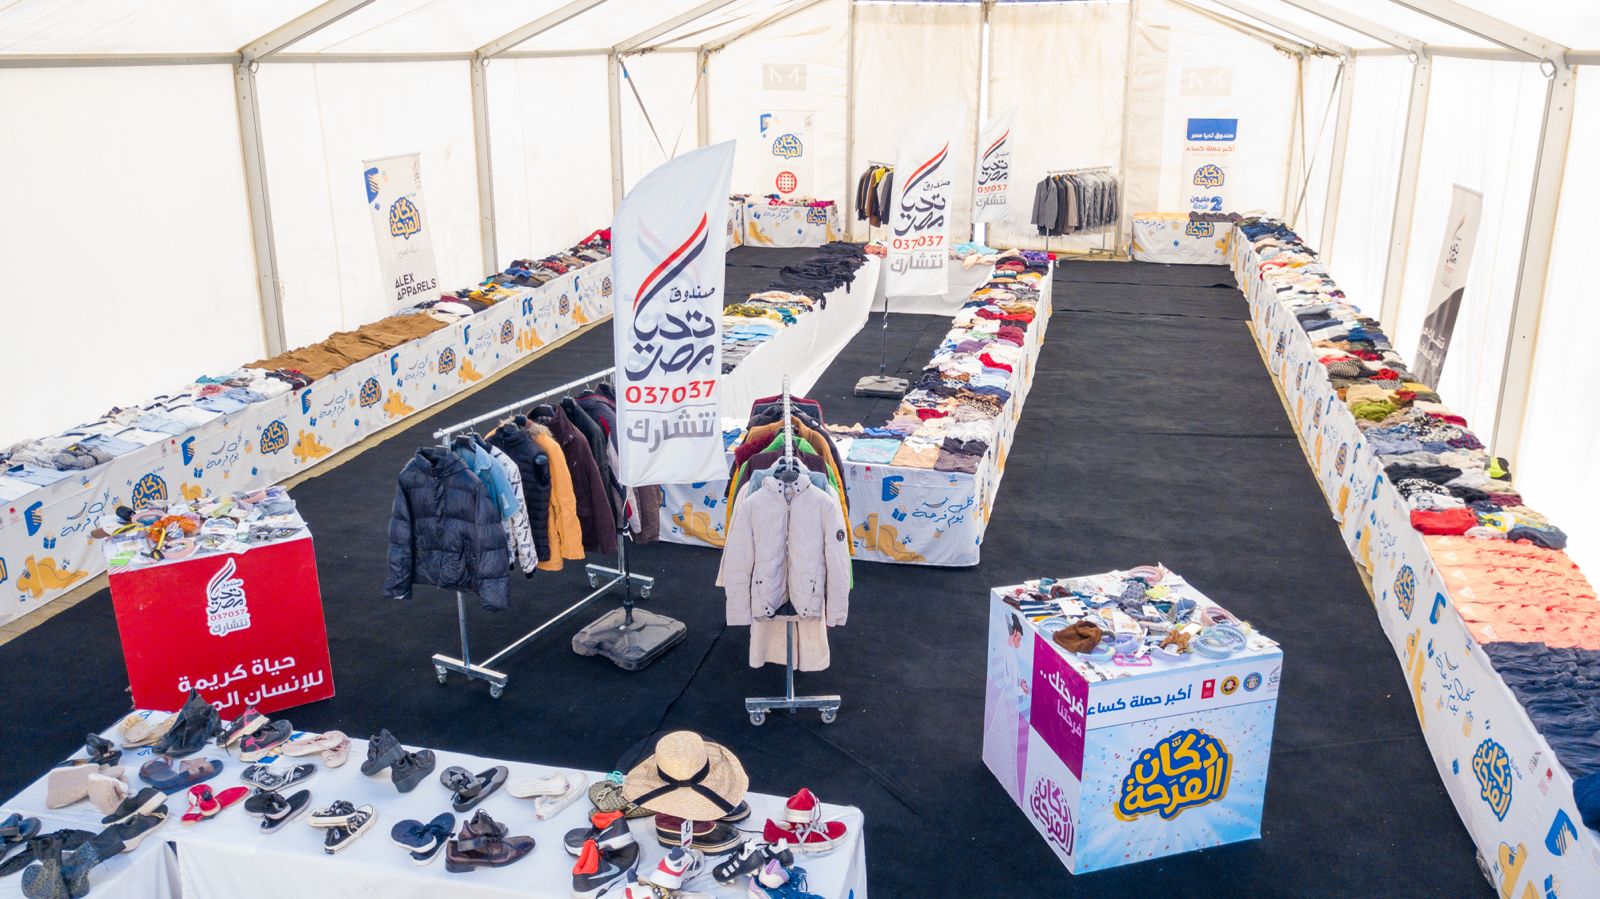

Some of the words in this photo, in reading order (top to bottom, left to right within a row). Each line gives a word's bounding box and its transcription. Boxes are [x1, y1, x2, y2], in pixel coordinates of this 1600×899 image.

[922, 180, 951, 192] صندوق
[1210, 195, 1223, 212] 2
[892, 236, 944, 250] 037037
[395, 272, 416, 289] ALEX
[397, 278, 437, 301] APPARELS
[669, 285, 716, 303] صندوق
[624, 342, 715, 382] مصر
[625, 380, 716, 405] 037037
[626, 409, 717, 453] نتشارك
[210, 609, 246, 622] 037037
[252, 656, 296, 677] حياة
[178, 664, 248, 693] كريمة
[244, 670, 324, 706] للإنسان
[1129, 693, 1163, 710] حملة
[1164, 684, 1194, 707] أكبر
[1056, 698, 1083, 739] فرحتنا
